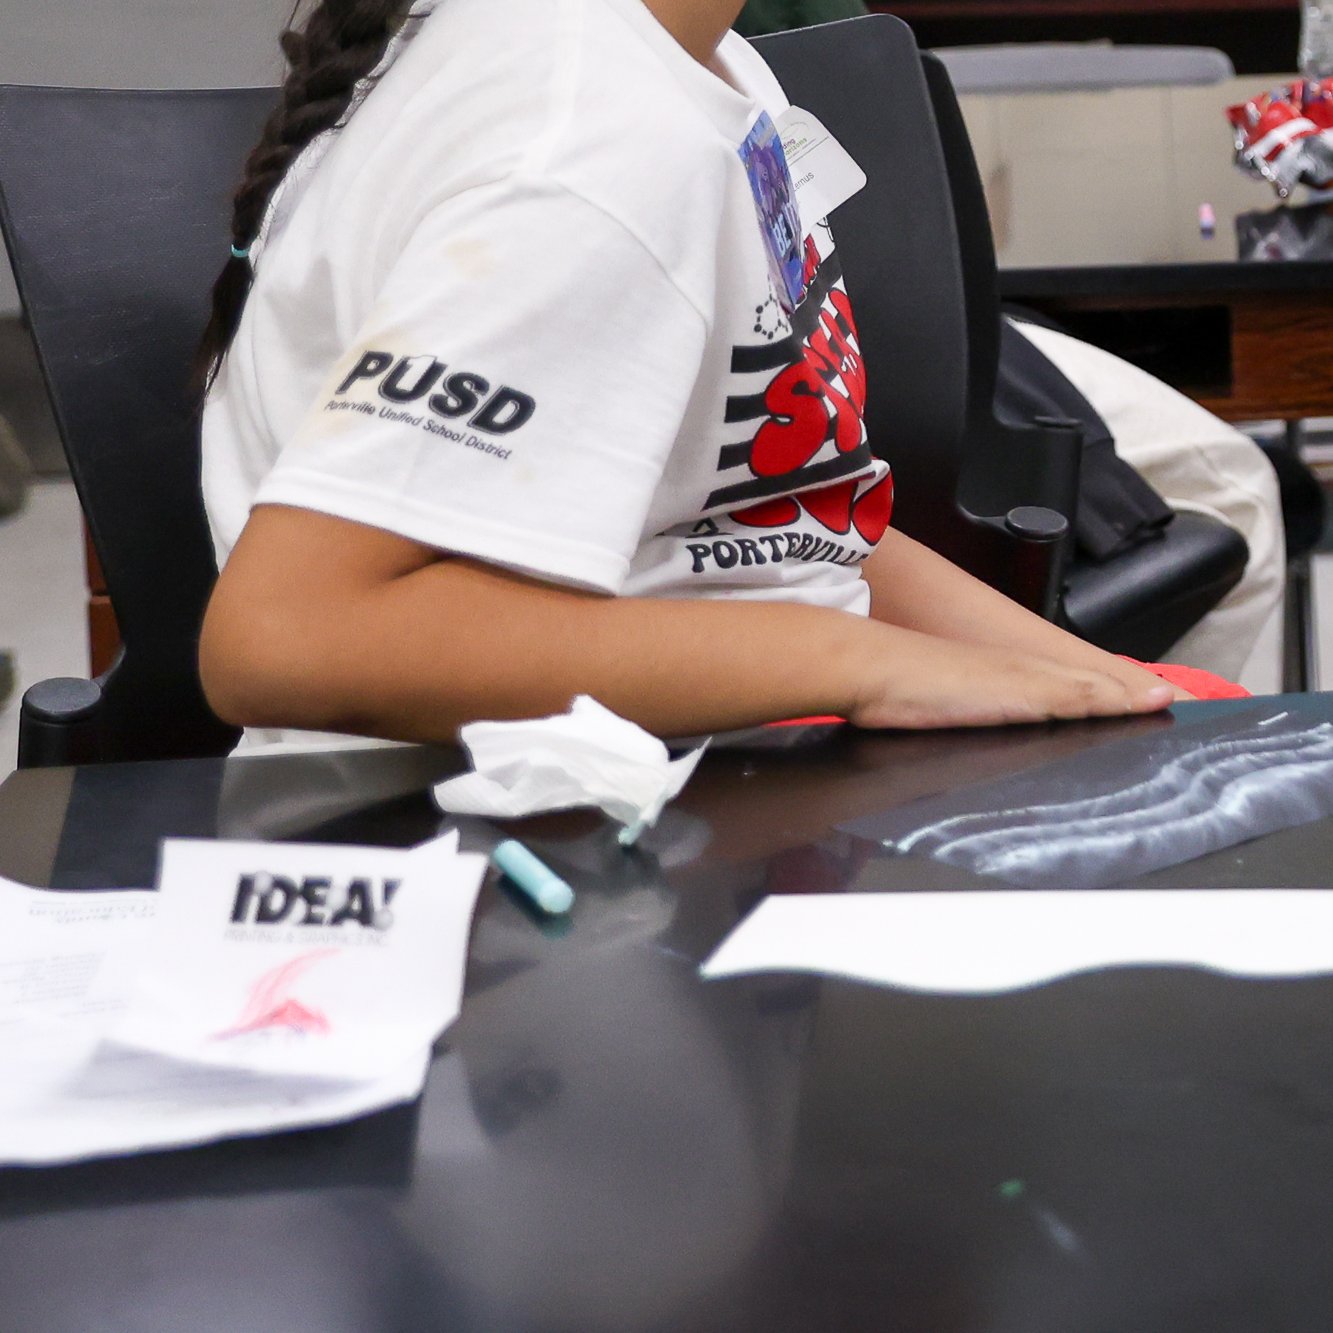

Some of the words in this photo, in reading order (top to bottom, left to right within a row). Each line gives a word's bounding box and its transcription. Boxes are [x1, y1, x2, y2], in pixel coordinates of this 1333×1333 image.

[784, 137, 808, 156] orizons
[335, 349, 537, 436] PUSD
[324, 399, 376, 416] Porterville
[378, 405, 424, 427] Unified
[423, 418, 465, 443] School
[465, 435, 513, 461] District
[229, 871, 403, 932] IDEA!
